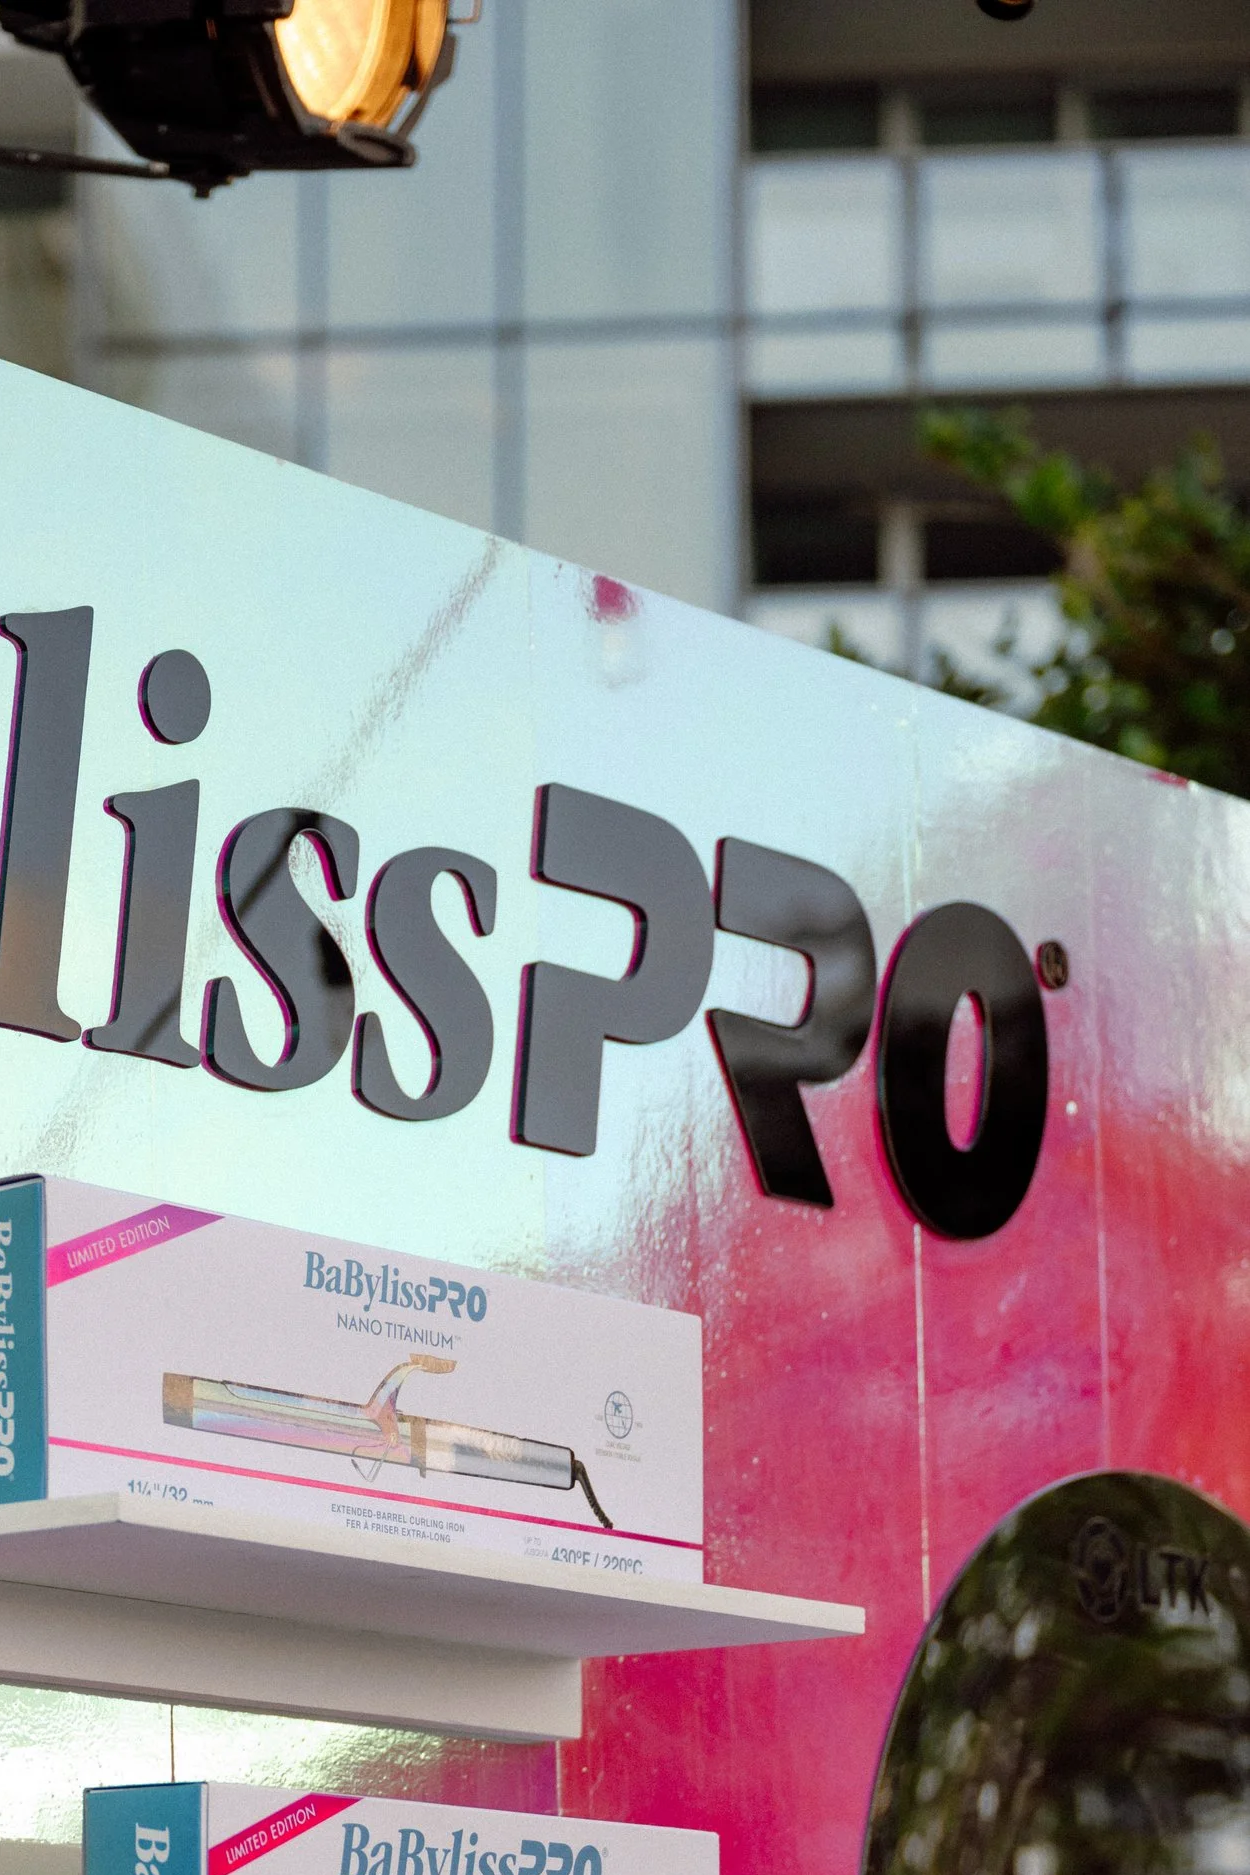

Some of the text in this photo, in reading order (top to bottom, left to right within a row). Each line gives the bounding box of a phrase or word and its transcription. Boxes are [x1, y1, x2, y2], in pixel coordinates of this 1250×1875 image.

[66, 1215, 171, 1269] LIMITED EDITION
[337, 1312, 382, 1336] NANO
[346, 1518, 362, 1530] FER
[371, 1522, 400, 1536] FRISER
[401, 1529, 452, 1543] EXTRA-LONG
[409, 1516, 445, 1531] CURLING
[445, 1520, 466, 1533] IRON
[225, 1803, 317, 1865] LIMITED EDITION
